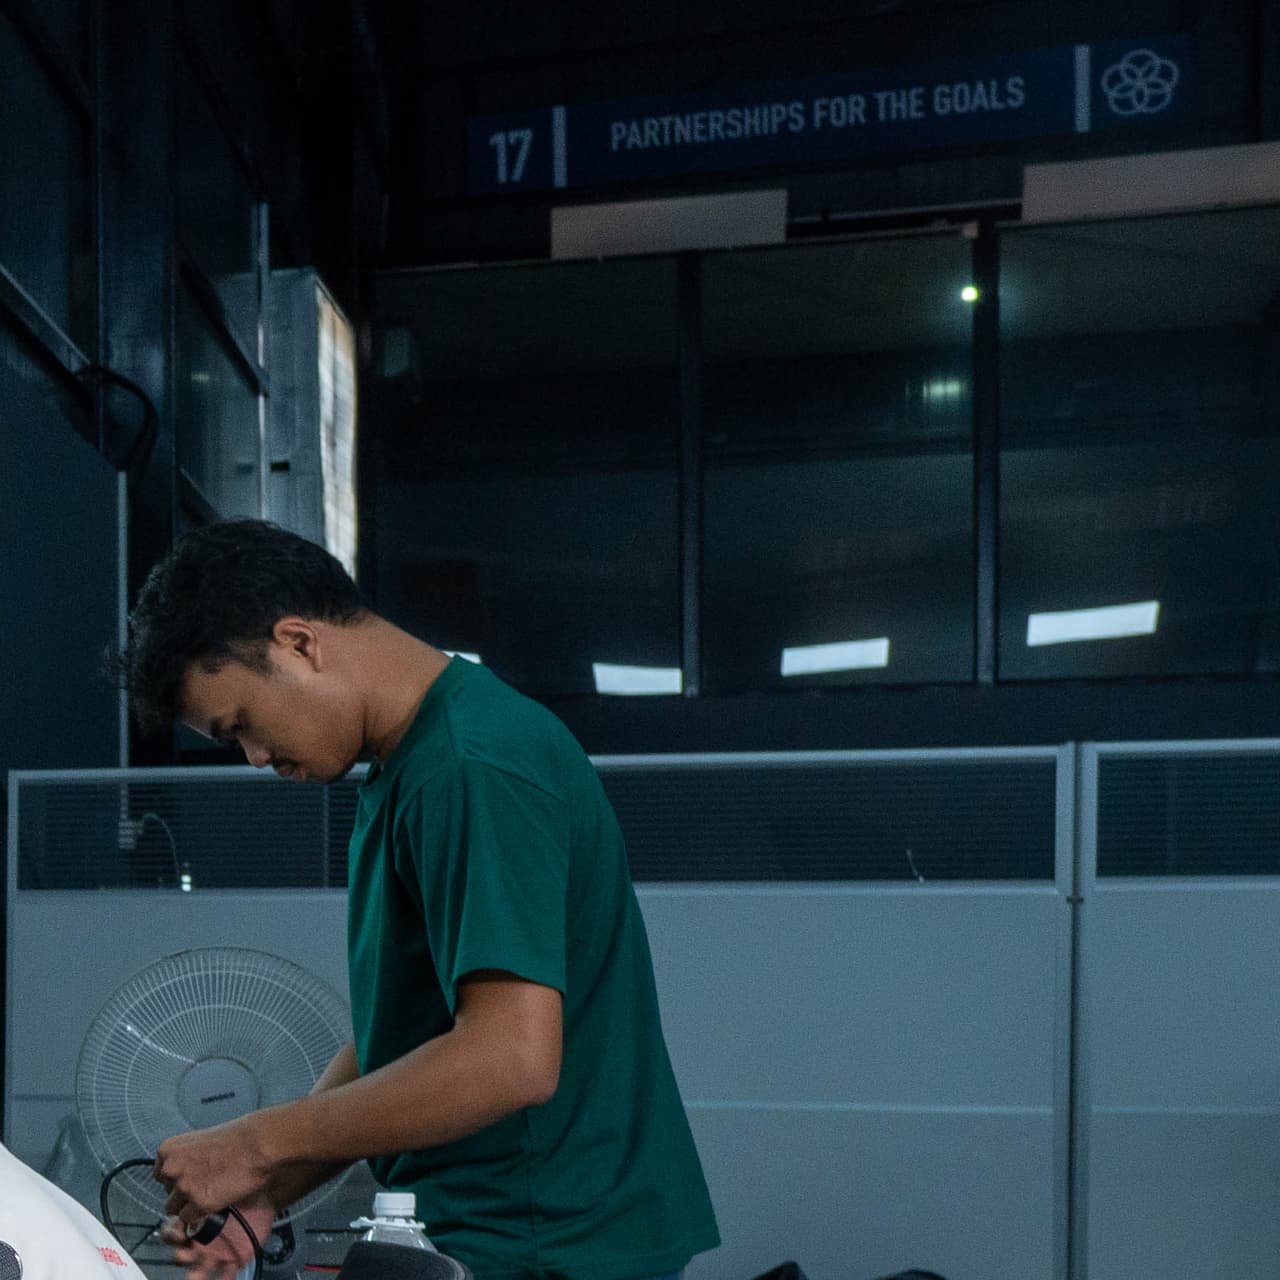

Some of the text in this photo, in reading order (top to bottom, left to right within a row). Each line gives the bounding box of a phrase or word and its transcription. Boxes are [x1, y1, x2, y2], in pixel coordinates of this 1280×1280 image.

[489, 76, 1025, 184] 17 PARTNERSHIPS FOR THE GOALS
